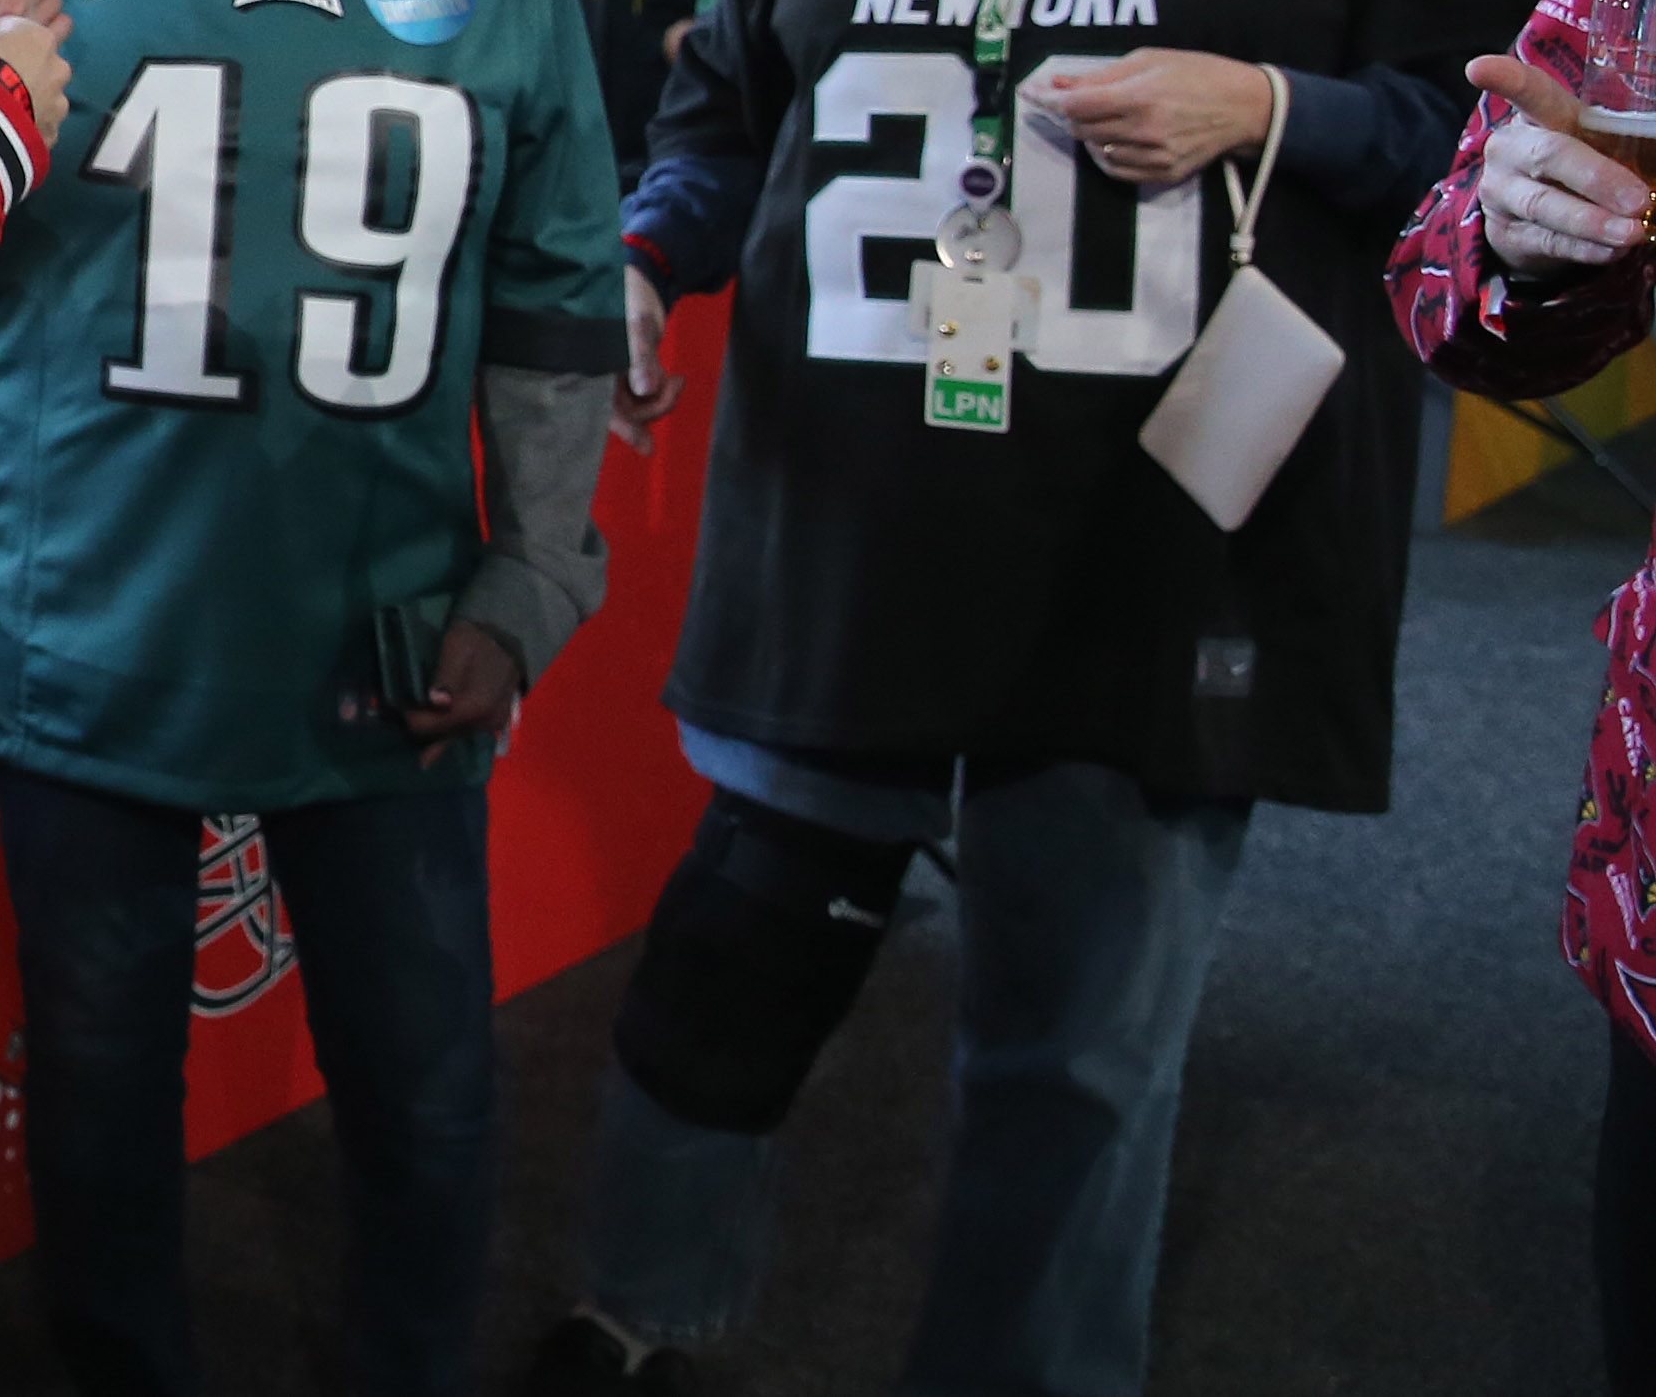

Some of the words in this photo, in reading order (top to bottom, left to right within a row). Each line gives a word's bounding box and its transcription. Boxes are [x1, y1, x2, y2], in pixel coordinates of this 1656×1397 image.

[78, 56, 485, 425] 19
[805, 51, 1204, 377] 20
[933, 388, 1004, 422] LPN
